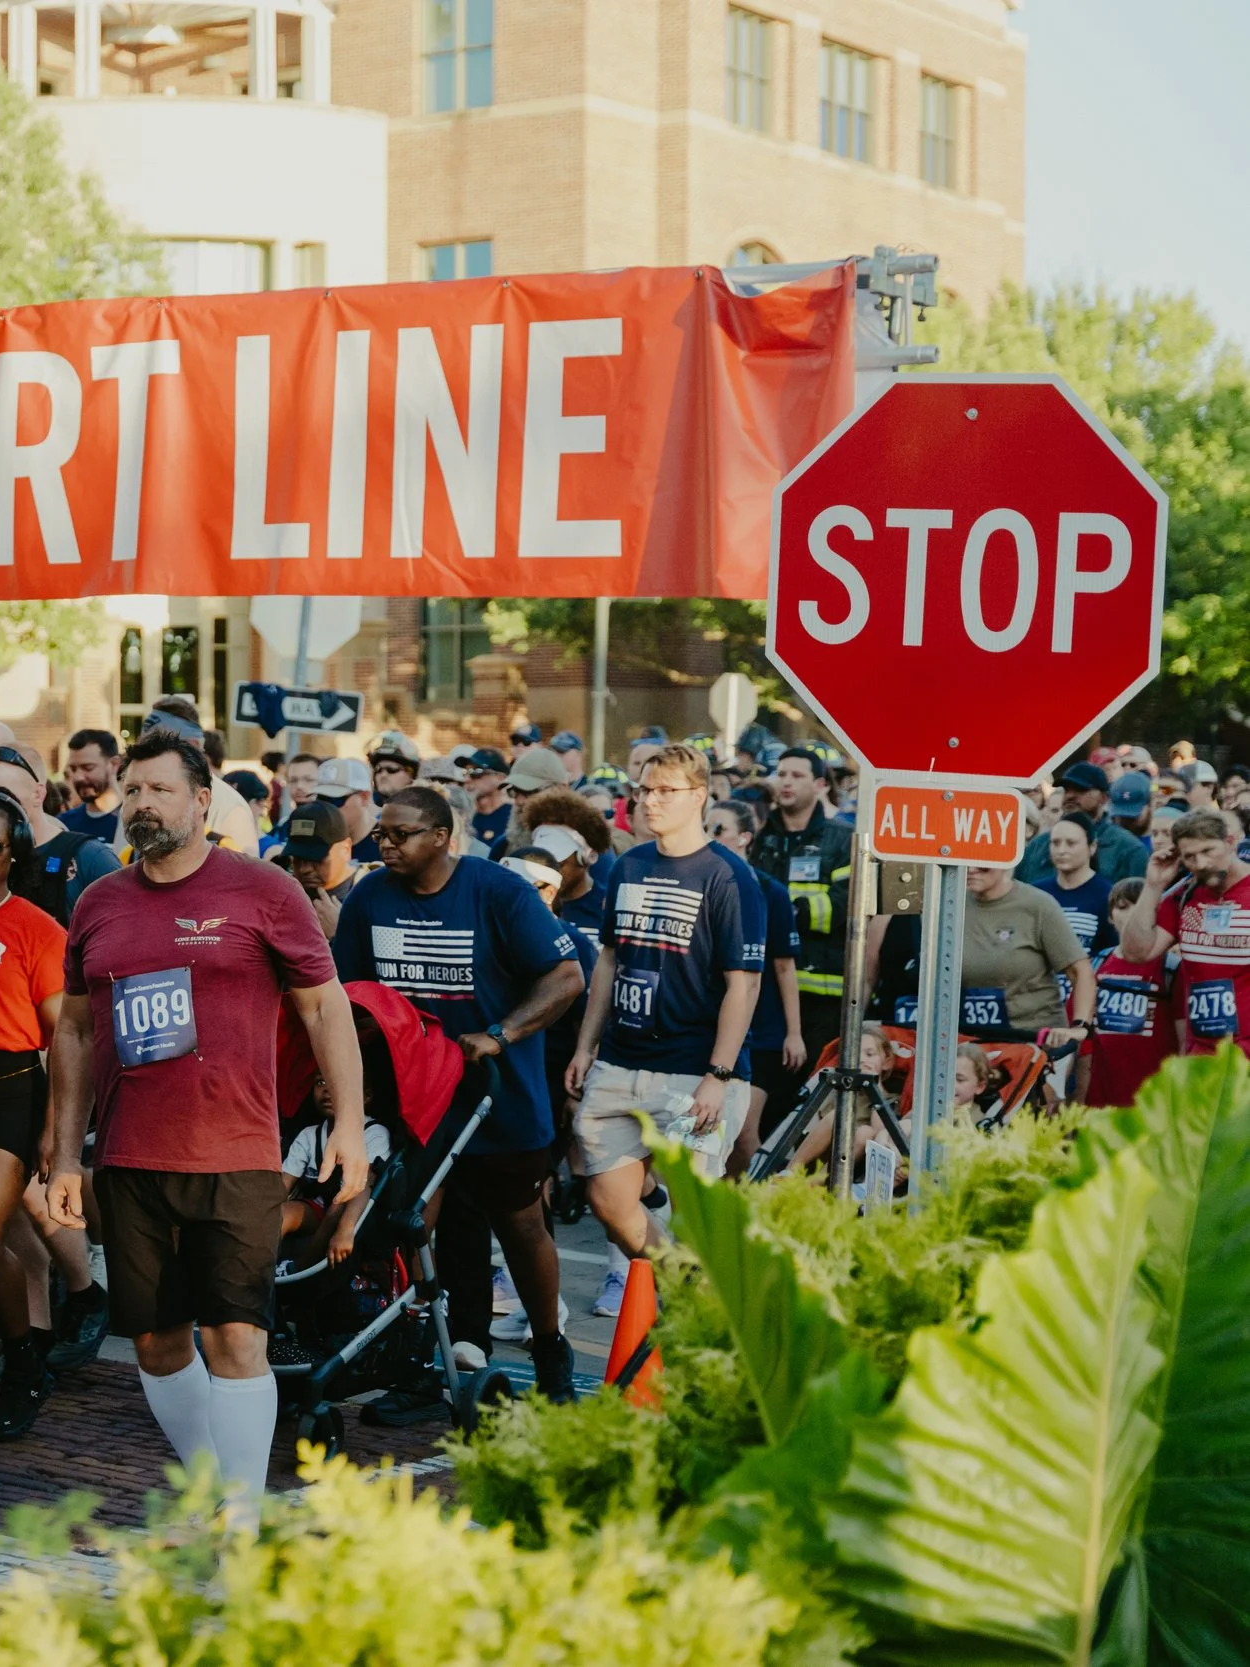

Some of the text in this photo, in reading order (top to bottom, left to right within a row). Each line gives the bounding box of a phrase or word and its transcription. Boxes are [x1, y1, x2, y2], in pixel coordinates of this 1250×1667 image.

[230, 317, 624, 561] LINE
[798, 504, 1133, 654] STOP
[879, 803, 1014, 846] ALL WAY
[634, 915, 654, 931] FOR
[376, 961, 474, 982] RUN FOR HEROES
[115, 988, 191, 1036] 1089
[614, 980, 653, 1016] 1481
[963, 1001, 1002, 1025] 352
[1098, 989, 1149, 1018] 2480
[1188, 991, 1237, 1020] 2478
